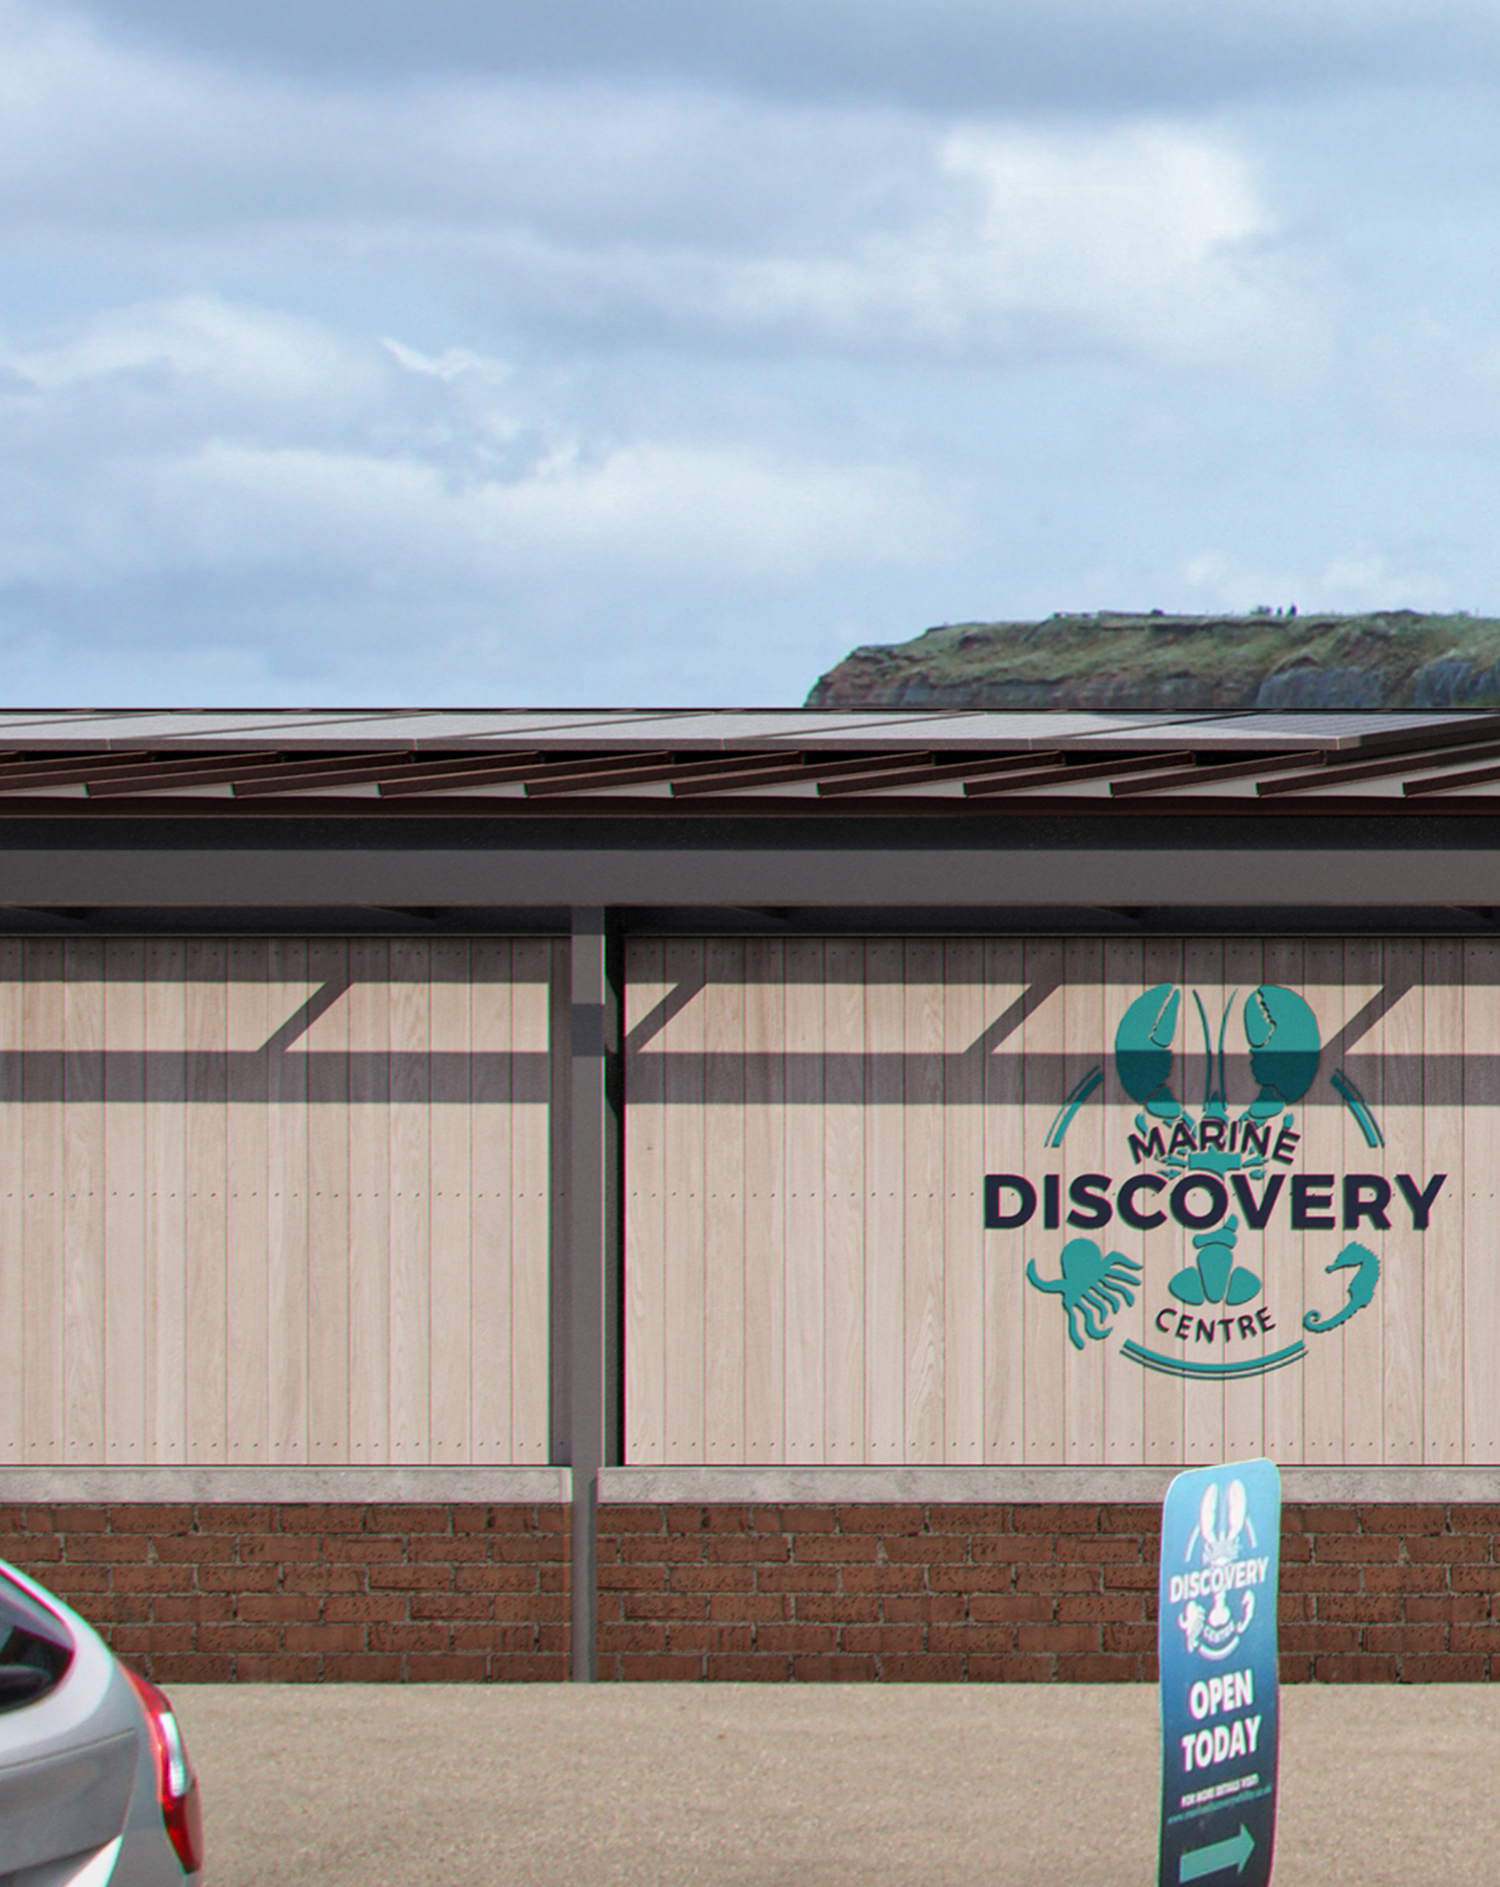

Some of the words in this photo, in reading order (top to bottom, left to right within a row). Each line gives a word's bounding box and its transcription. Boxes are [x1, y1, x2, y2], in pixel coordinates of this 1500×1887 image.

[1128, 1119, 1301, 1165] MARINE
[983, 1173, 1447, 1231] DISCOVERY
[1155, 1307, 1277, 1344] CENTRE
[1169, 1555, 1269, 1604] DISCOVERY
[1189, 1668, 1253, 1720] OPEN
[1181, 1715, 1262, 1772] TODAY
